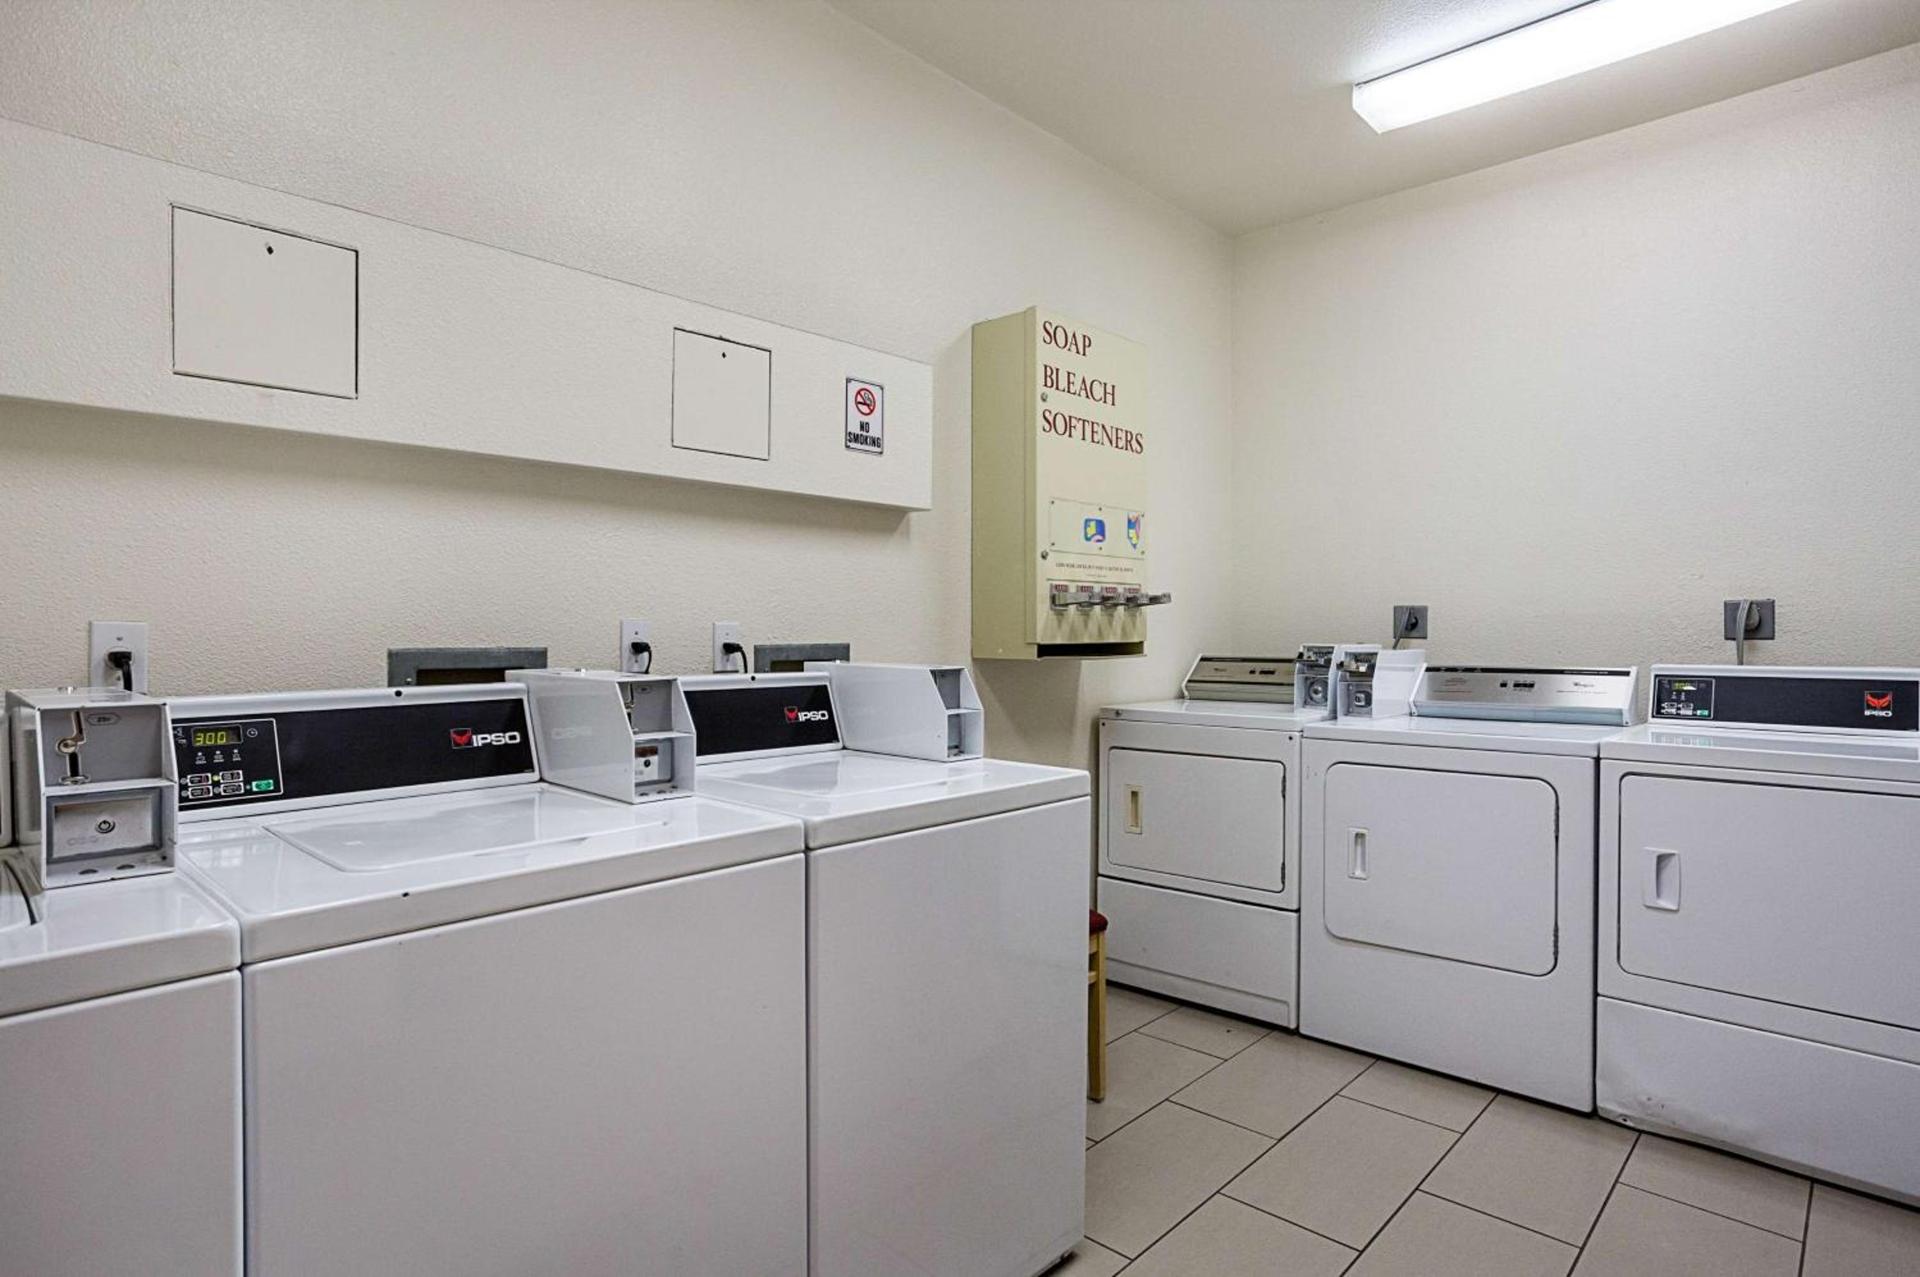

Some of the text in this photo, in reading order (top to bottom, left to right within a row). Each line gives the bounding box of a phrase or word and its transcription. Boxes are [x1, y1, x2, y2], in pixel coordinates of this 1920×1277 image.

[1042, 320, 1092, 357] SOAP
[1043, 364, 1116, 406] BLEACH
[859, 420, 870, 433] NO
[1042, 409, 1144, 454] SOFTENERS
[848, 431, 882, 448] SMOKING
[798, 710, 829, 722] IPSO
[472, 731, 520, 747] IPSO
